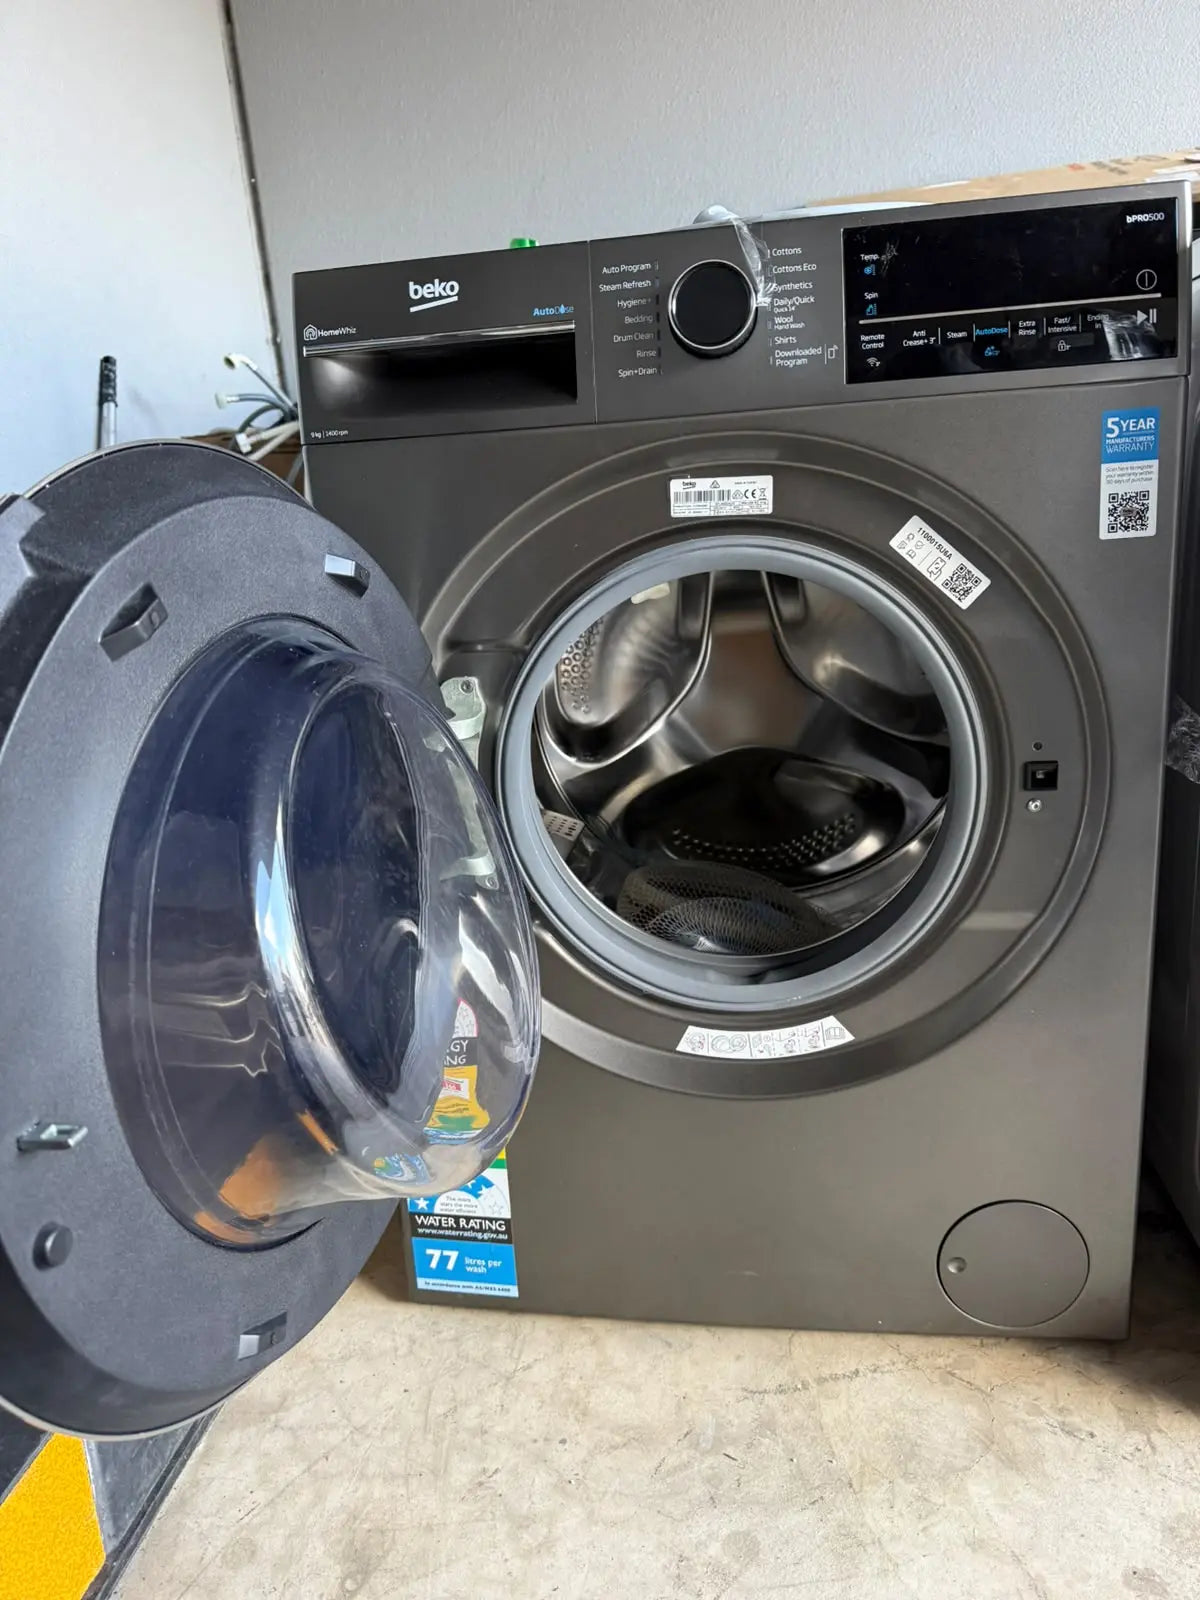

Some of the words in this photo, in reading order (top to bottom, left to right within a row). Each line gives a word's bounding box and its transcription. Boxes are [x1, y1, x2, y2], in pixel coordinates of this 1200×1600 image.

[1126, 212, 1165, 223] bPRO500
[772, 246, 802, 256] Cottons
[860, 253, 879, 263] Temp.
[602, 266, 619, 274] Auto
[620, 263, 651, 273] Program
[772, 264, 801, 275] Cottons
[802, 263, 817, 272] Eco
[408, 278, 460, 300] beko
[599, 284, 621, 292] Steam
[622, 280, 651, 289] Refresh
[773, 282, 813, 293] Synthetics
[864, 291, 878, 300] Spin
[774, 296, 815, 306] Daily/Quick
[624, 315, 653, 324] Bedding
[774, 315, 793, 323] Wool
[1018, 319, 1036, 328] Extra
[1053, 315, 1071, 324] Fast/
[317, 326, 357, 338] HomeWhiz
[912, 329, 926, 338] Anti
[946, 330, 968, 339] Steam
[975, 326, 1009, 336] AutoDose
[1018, 328, 1036, 336] Rinse
[1047, 325, 1077, 334] Intensive
[613, 334, 633, 343] Drum
[634, 332, 654, 341] Clean
[774, 335, 797, 345] Shirts
[860, 333, 885, 342] Remote
[861, 341, 884, 350] Control
[636, 349, 657, 358] Rinse
[774, 346, 822, 358] Downloaded
[775, 358, 808, 368] Program
[617, 367, 658, 378] Spin+Drain
[1106, 417, 1120, 438] 5
[1120, 417, 1156, 432] YEAR
[1105, 441, 1155, 454] WARRANTY
[917, 527, 953, 560] 1100015U6A
[415, 1215, 457, 1228] WATER
[459, 1218, 506, 1231] RATING
[416, 1227, 508, 1240] www.waterrating.gov.au
[425, 1248, 459, 1272] 77
[464, 1256, 486, 1266] litres
[487, 1259, 502, 1268] per
[465, 1265, 487, 1274] wash
